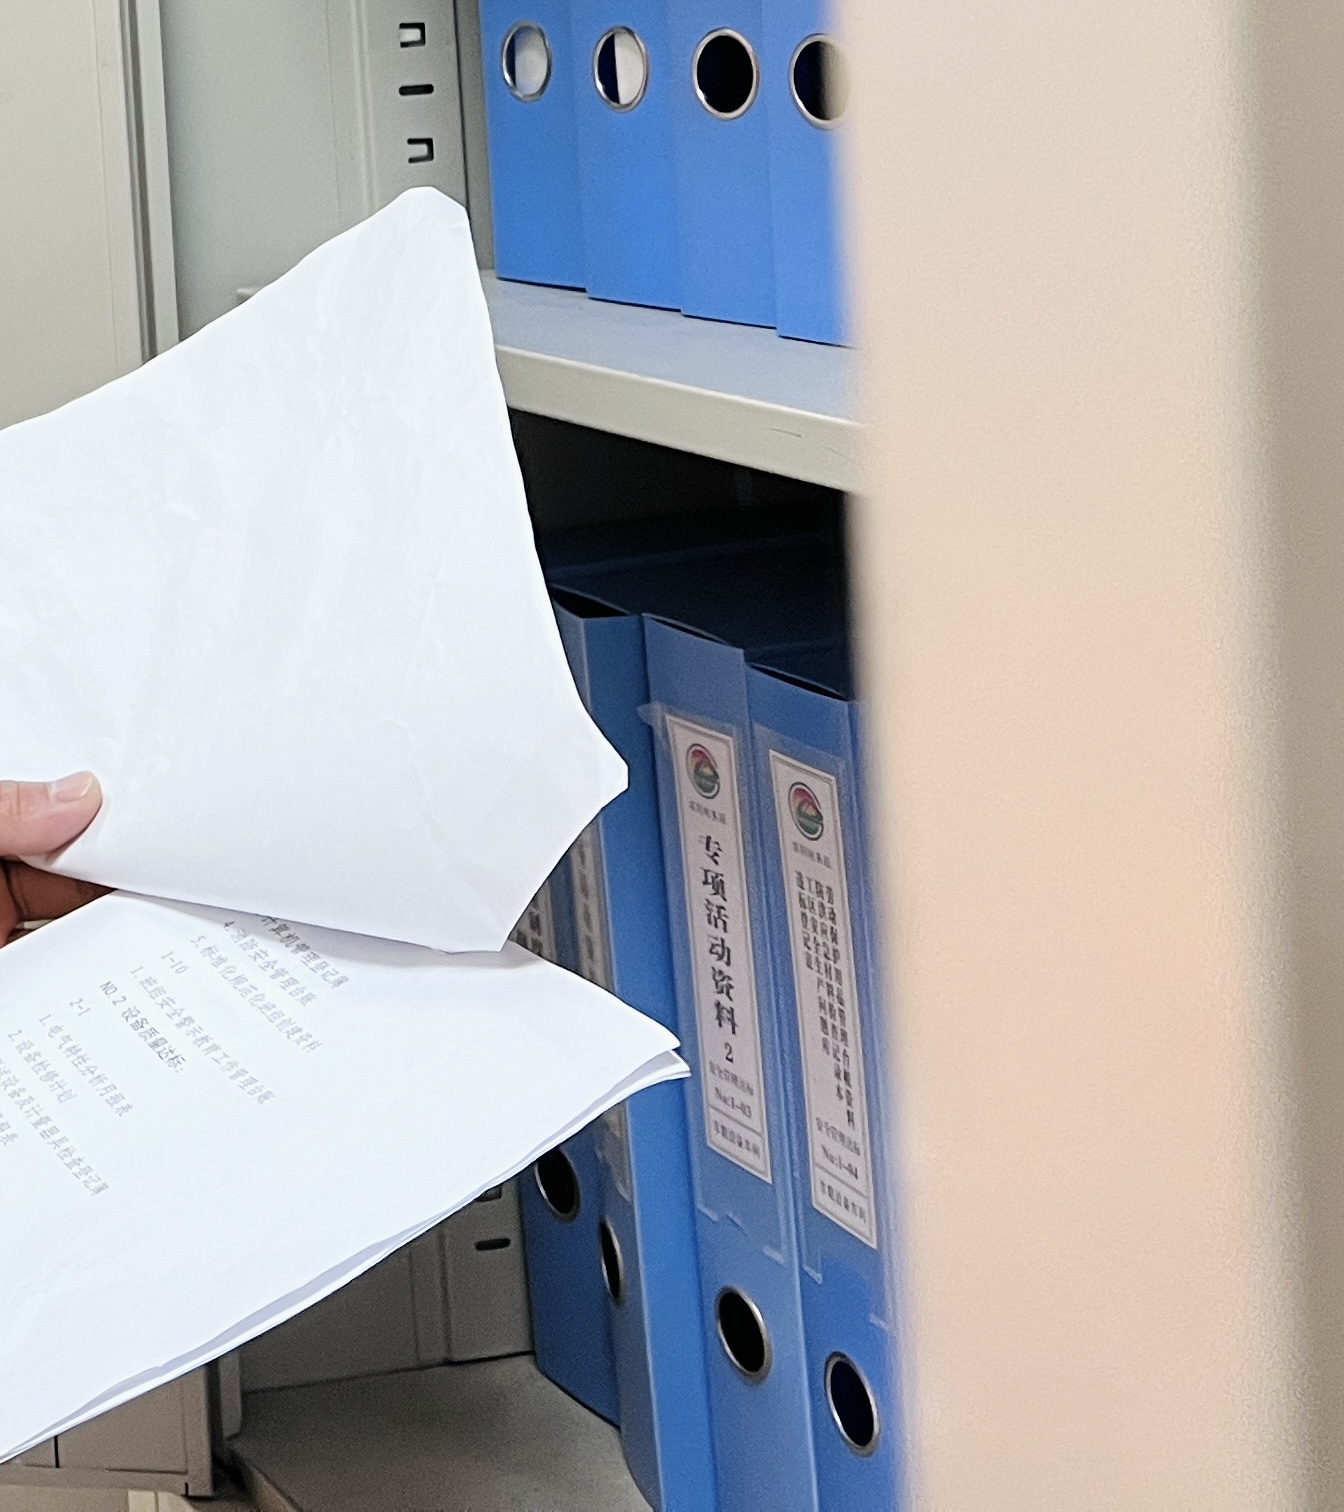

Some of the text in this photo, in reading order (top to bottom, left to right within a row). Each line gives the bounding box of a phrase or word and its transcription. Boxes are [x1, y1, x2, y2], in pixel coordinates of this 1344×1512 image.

[698, 835, 739, 1063] 专项活动资料 2
[160, 950, 189, 974] 1-10
[68, 996, 91, 1017] 2-1
